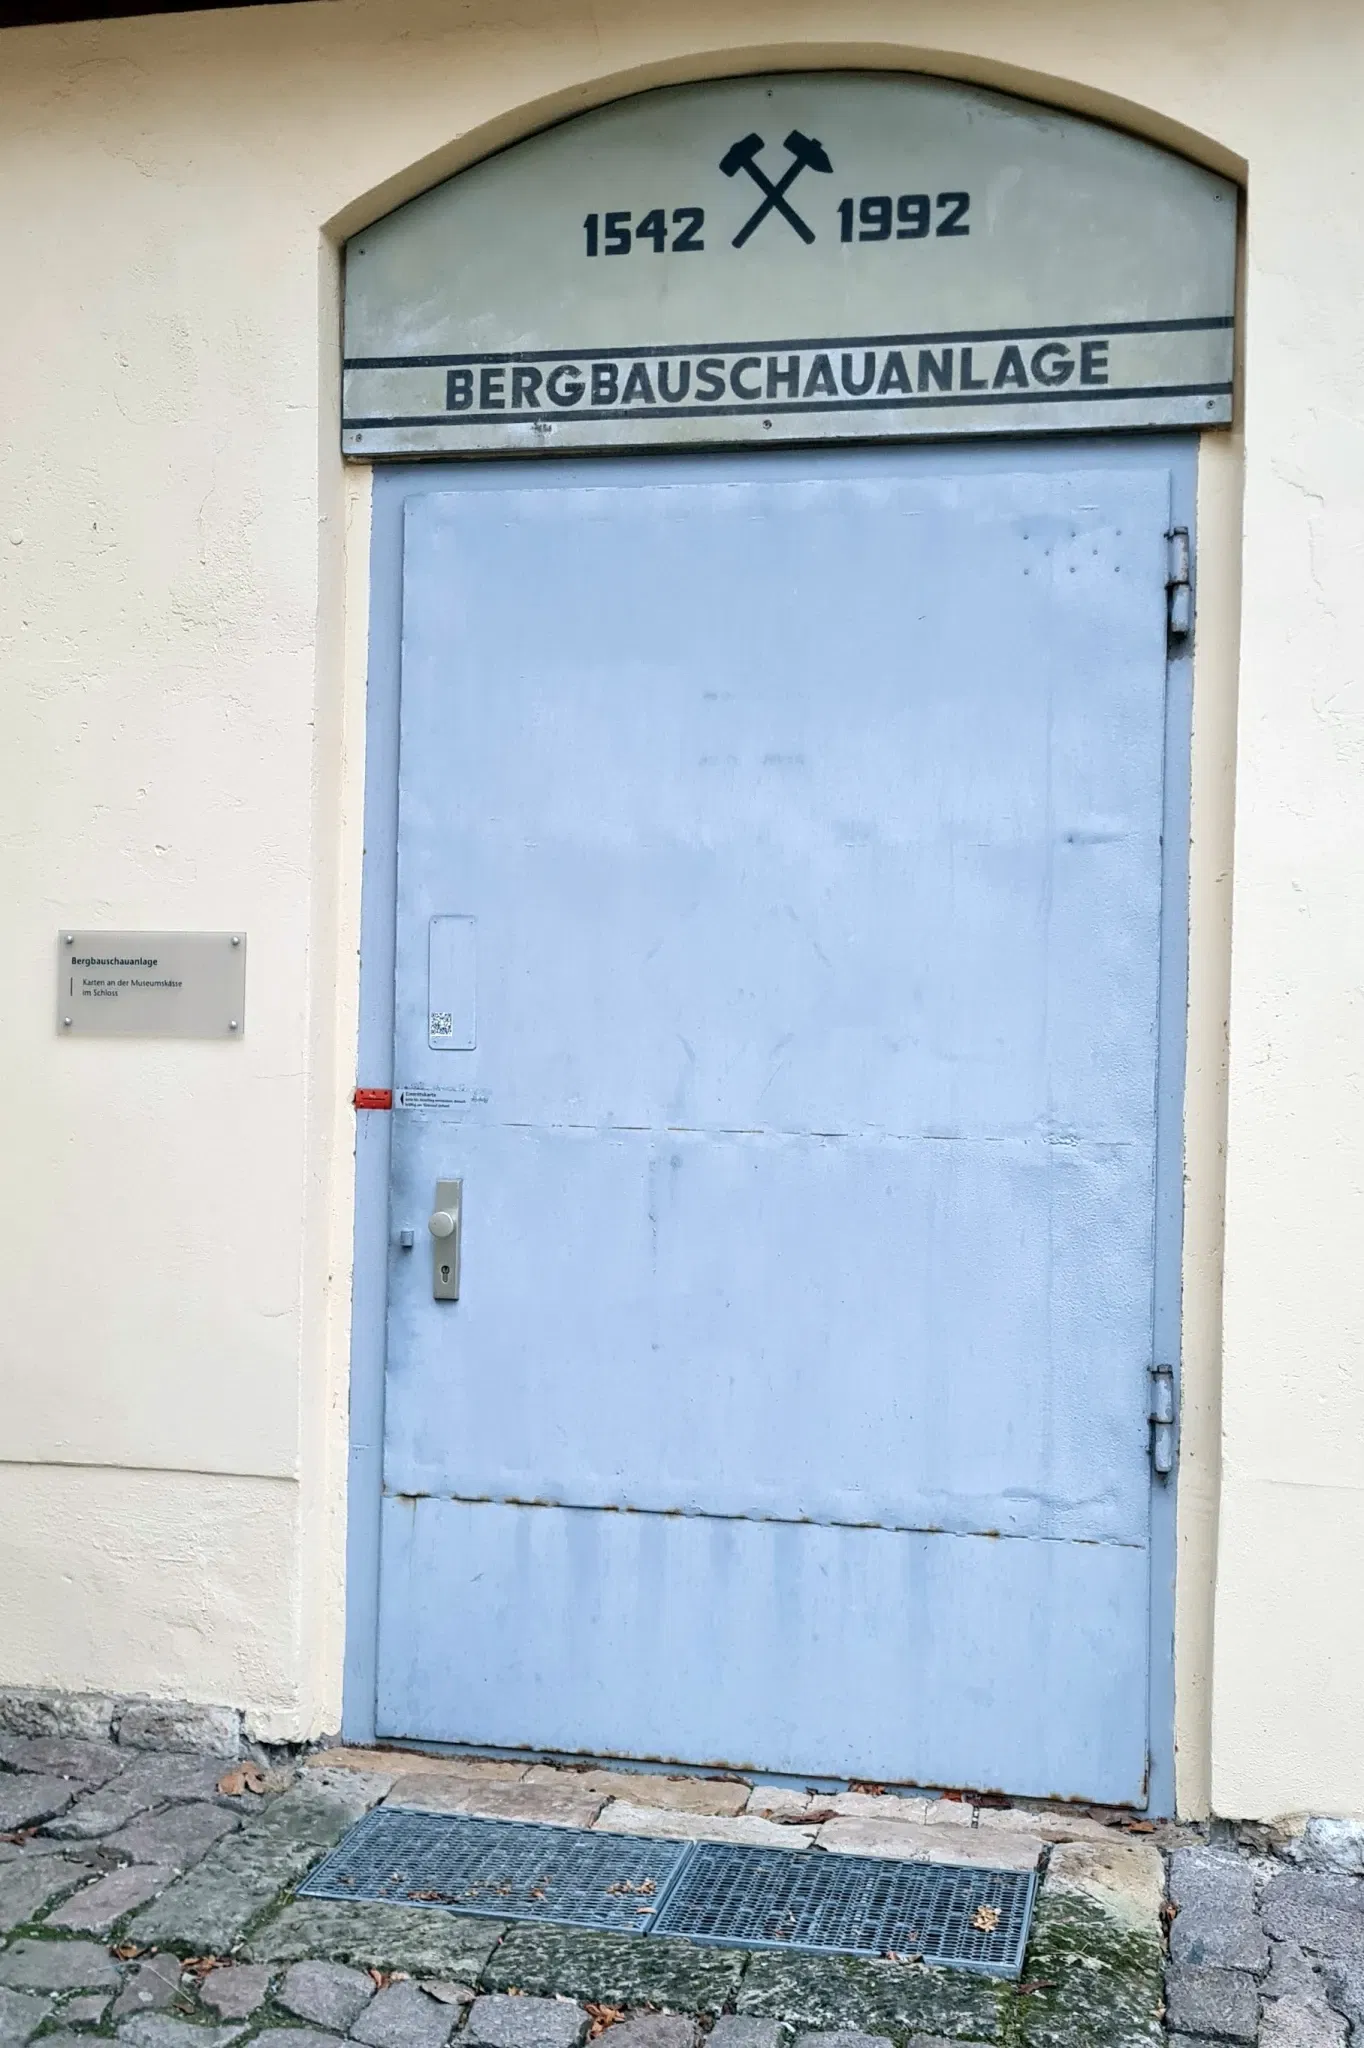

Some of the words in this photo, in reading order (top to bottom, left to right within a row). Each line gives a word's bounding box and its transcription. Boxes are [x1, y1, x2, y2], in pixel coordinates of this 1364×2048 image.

[583, 207, 706, 257] 1542
[837, 192, 971, 243] 1992
[446, 341, 1110, 411] BERGBAUSCHAUANLAGE
[71, 957, 158, 967] Bergbauschauanlage
[93, 989, 118, 997] Schloss
